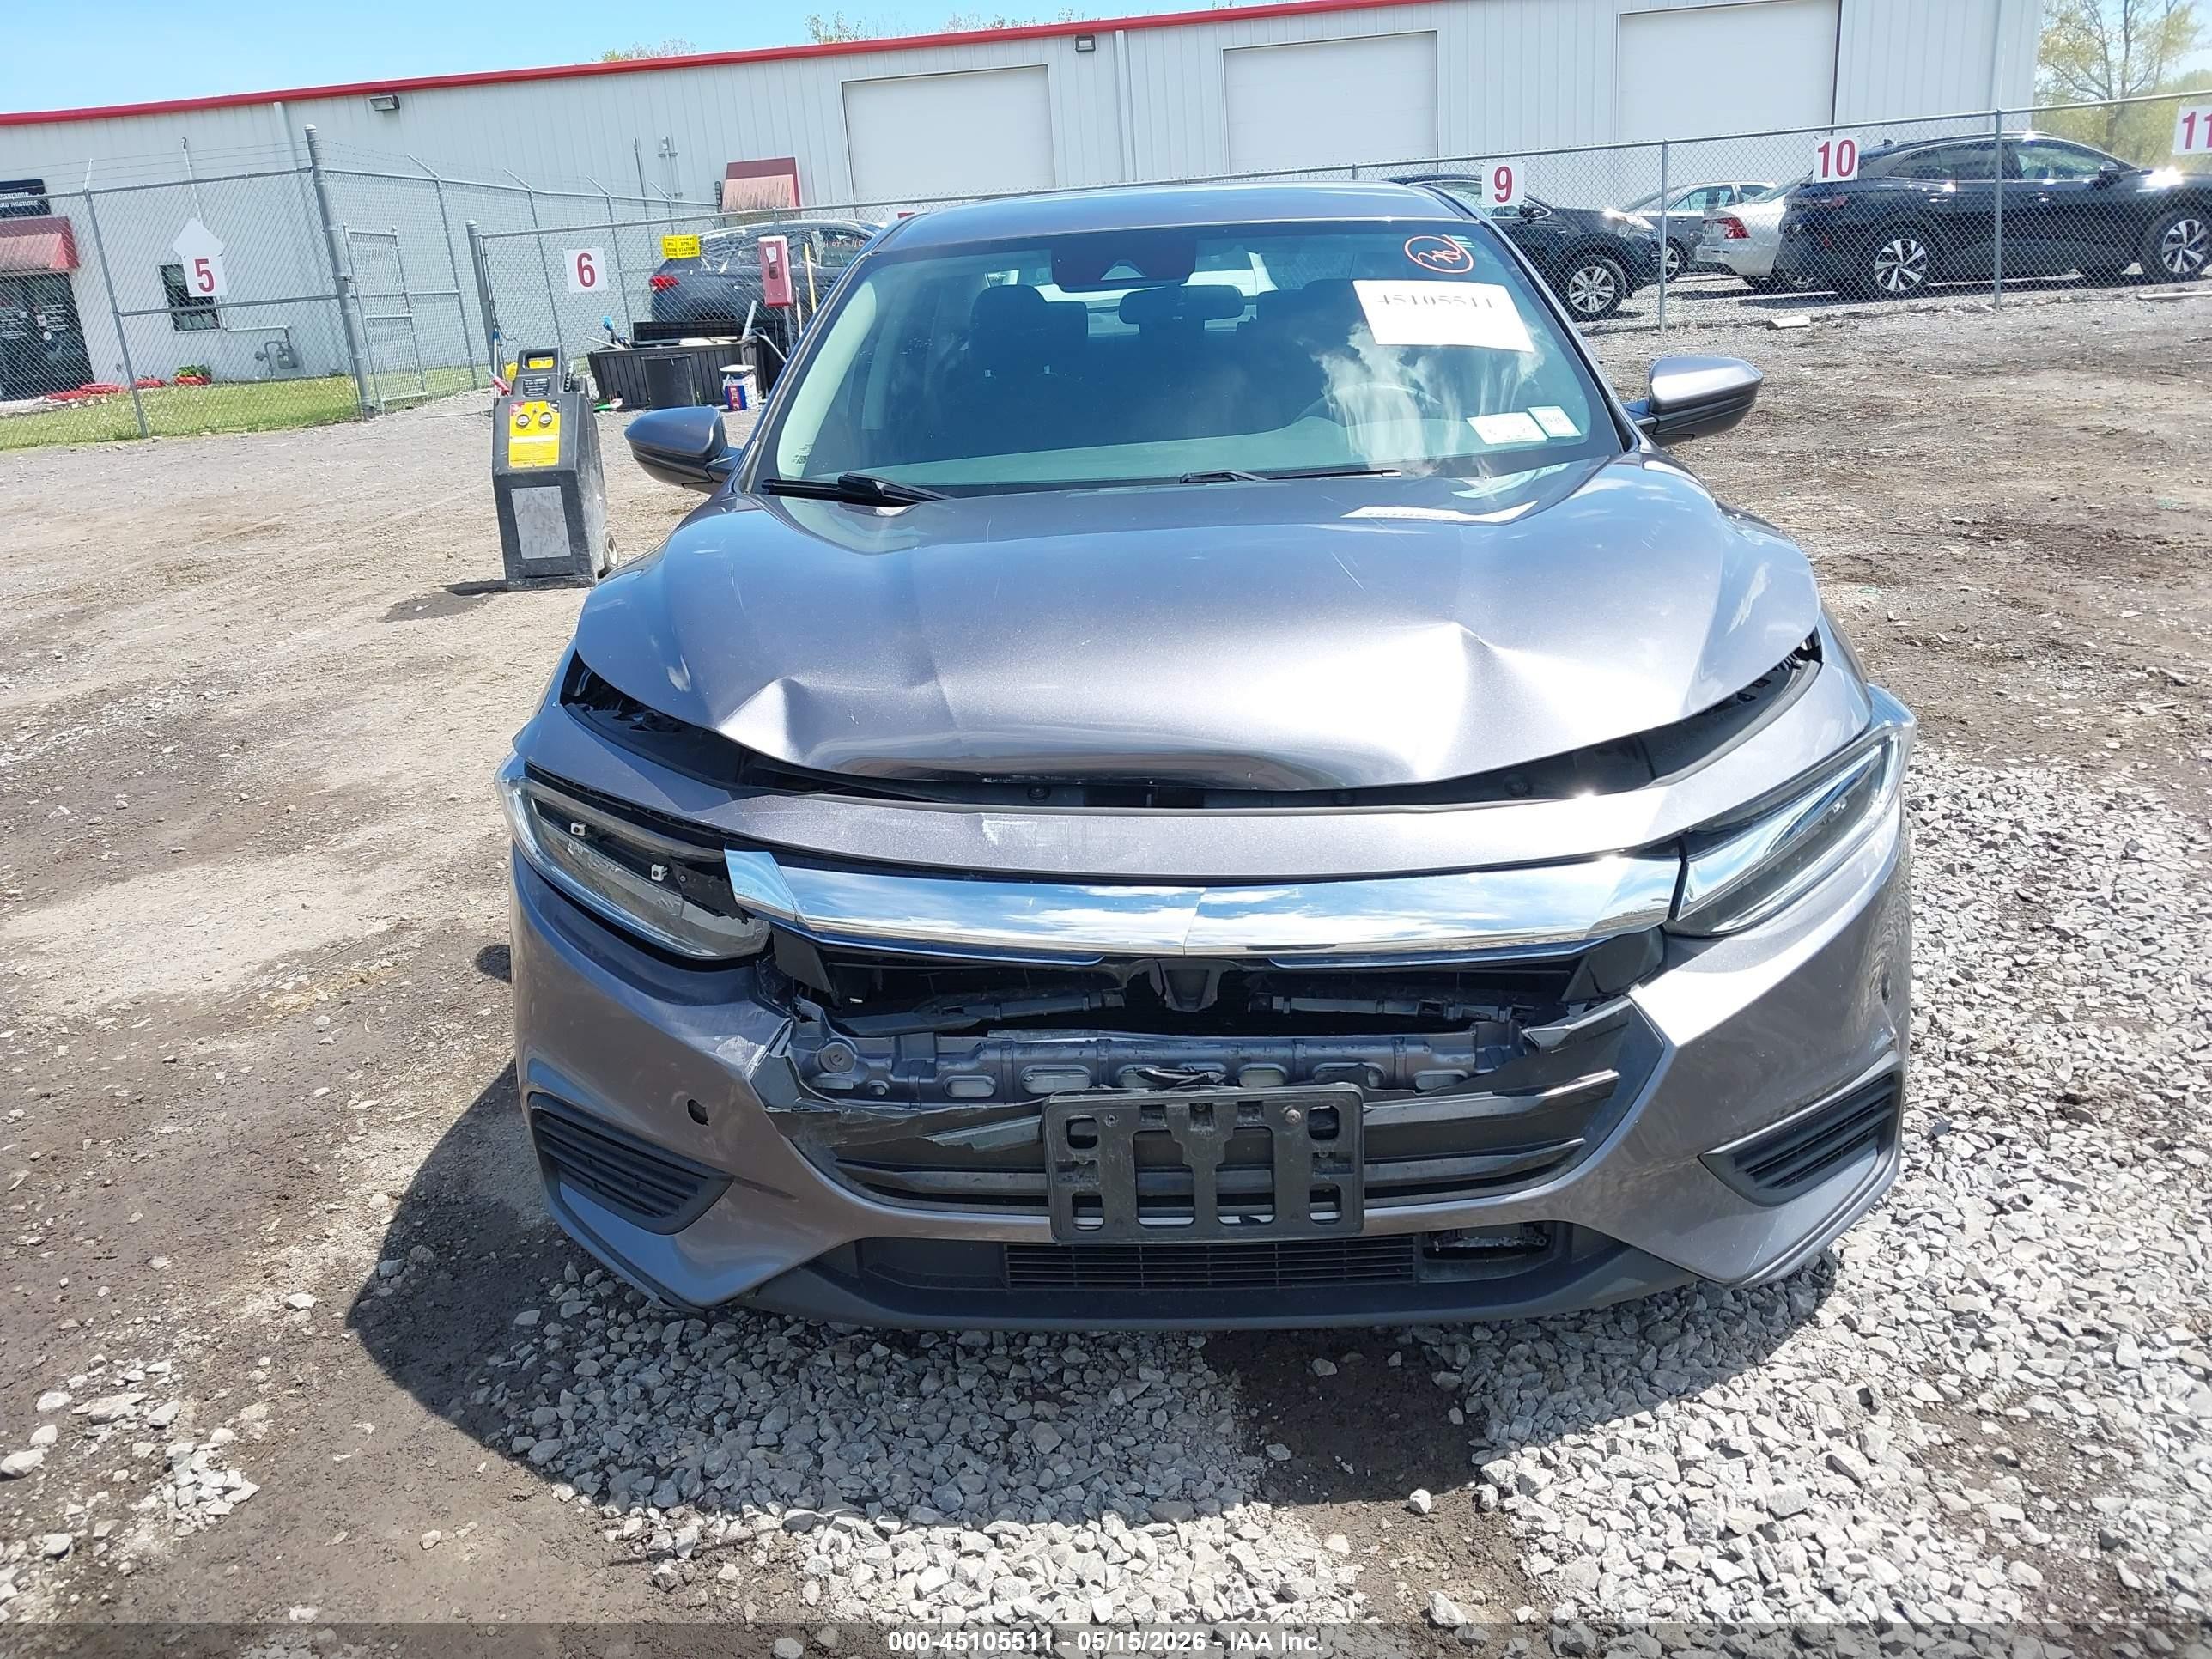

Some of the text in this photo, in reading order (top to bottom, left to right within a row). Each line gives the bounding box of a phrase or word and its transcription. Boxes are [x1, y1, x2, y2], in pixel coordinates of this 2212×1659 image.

[1817, 139, 1856, 178] 10
[1494, 166, 1513, 203] 9
[194, 258, 215, 292] 5
[577, 252, 596, 288] 6
